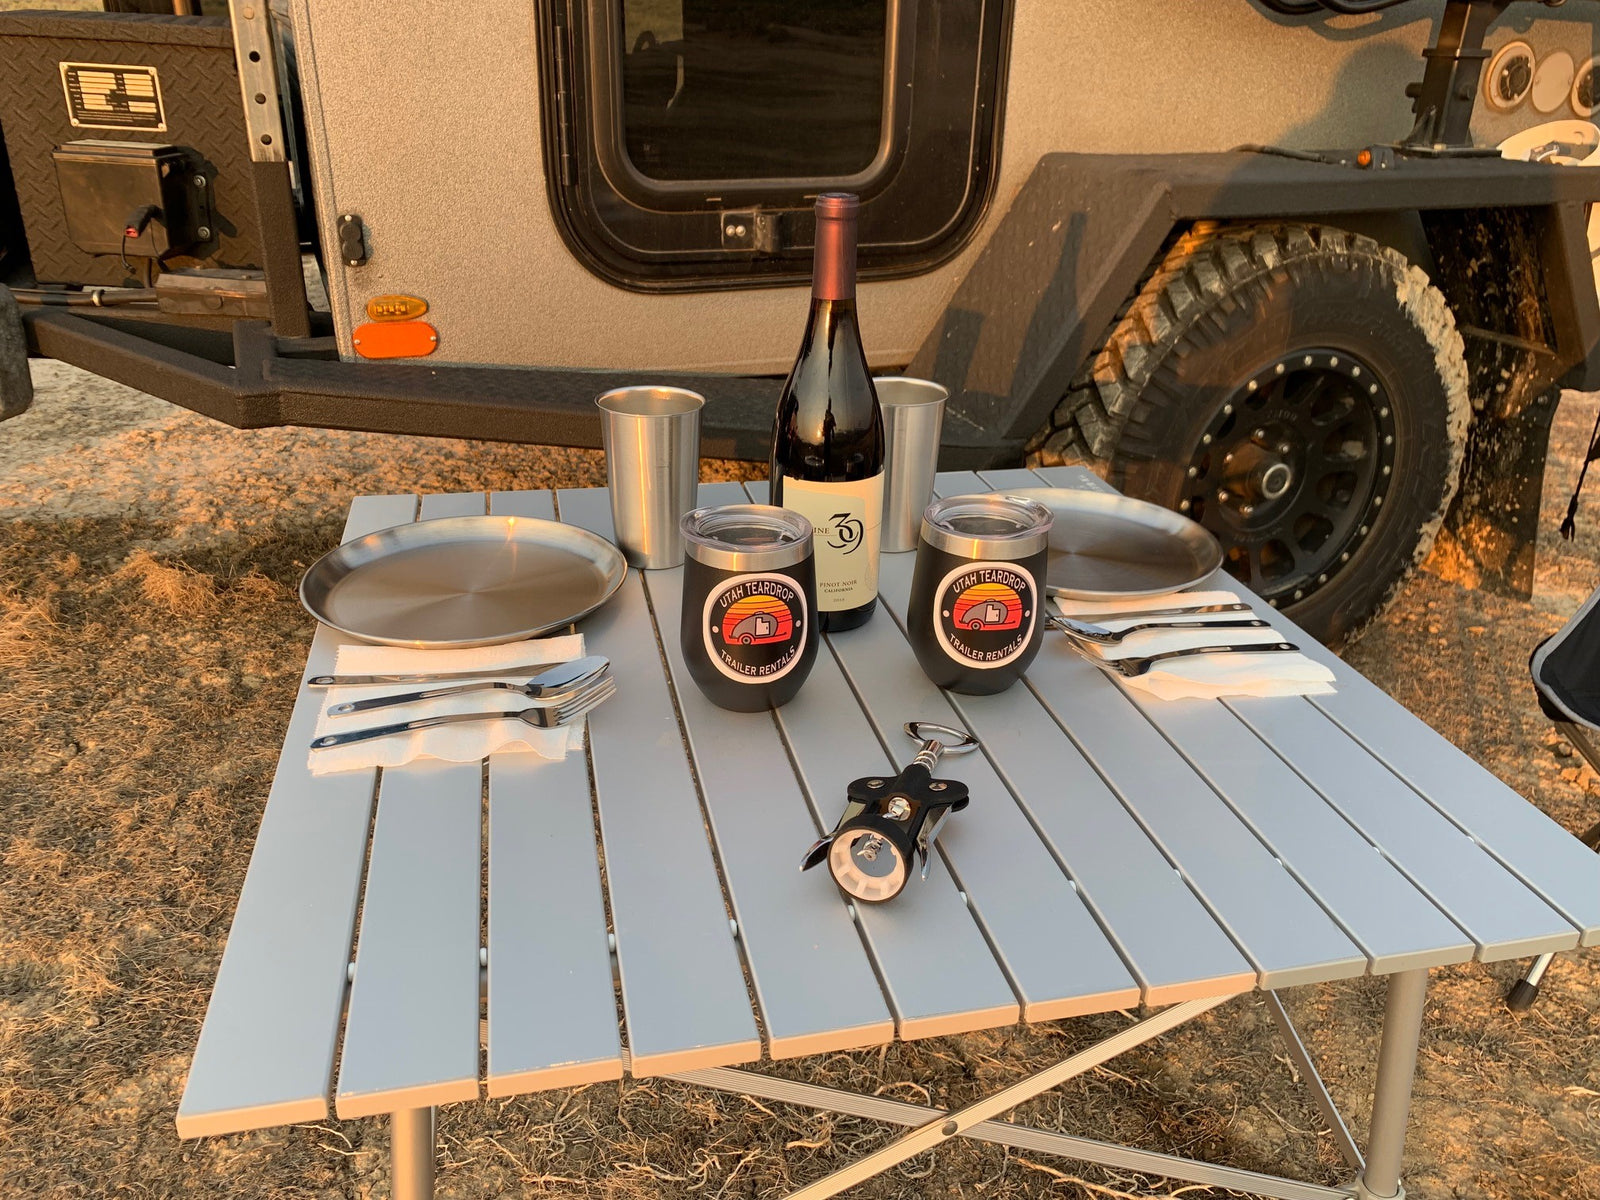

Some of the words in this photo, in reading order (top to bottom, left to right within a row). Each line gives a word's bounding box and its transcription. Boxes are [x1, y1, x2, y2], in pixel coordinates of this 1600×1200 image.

[827, 512, 864, 555] 39
[719, 585, 744, 608] UTAH
[745, 581, 795, 603] TEARDROP
[952, 572, 978, 593] UTAH
[979, 569, 1027, 592] TEARDROP
[721, 649, 757, 676] TRAILER
[759, 645, 795, 675] RENTALS
[950, 633, 984, 661] TRAILER
[985, 634, 1022, 661] RENTALS
